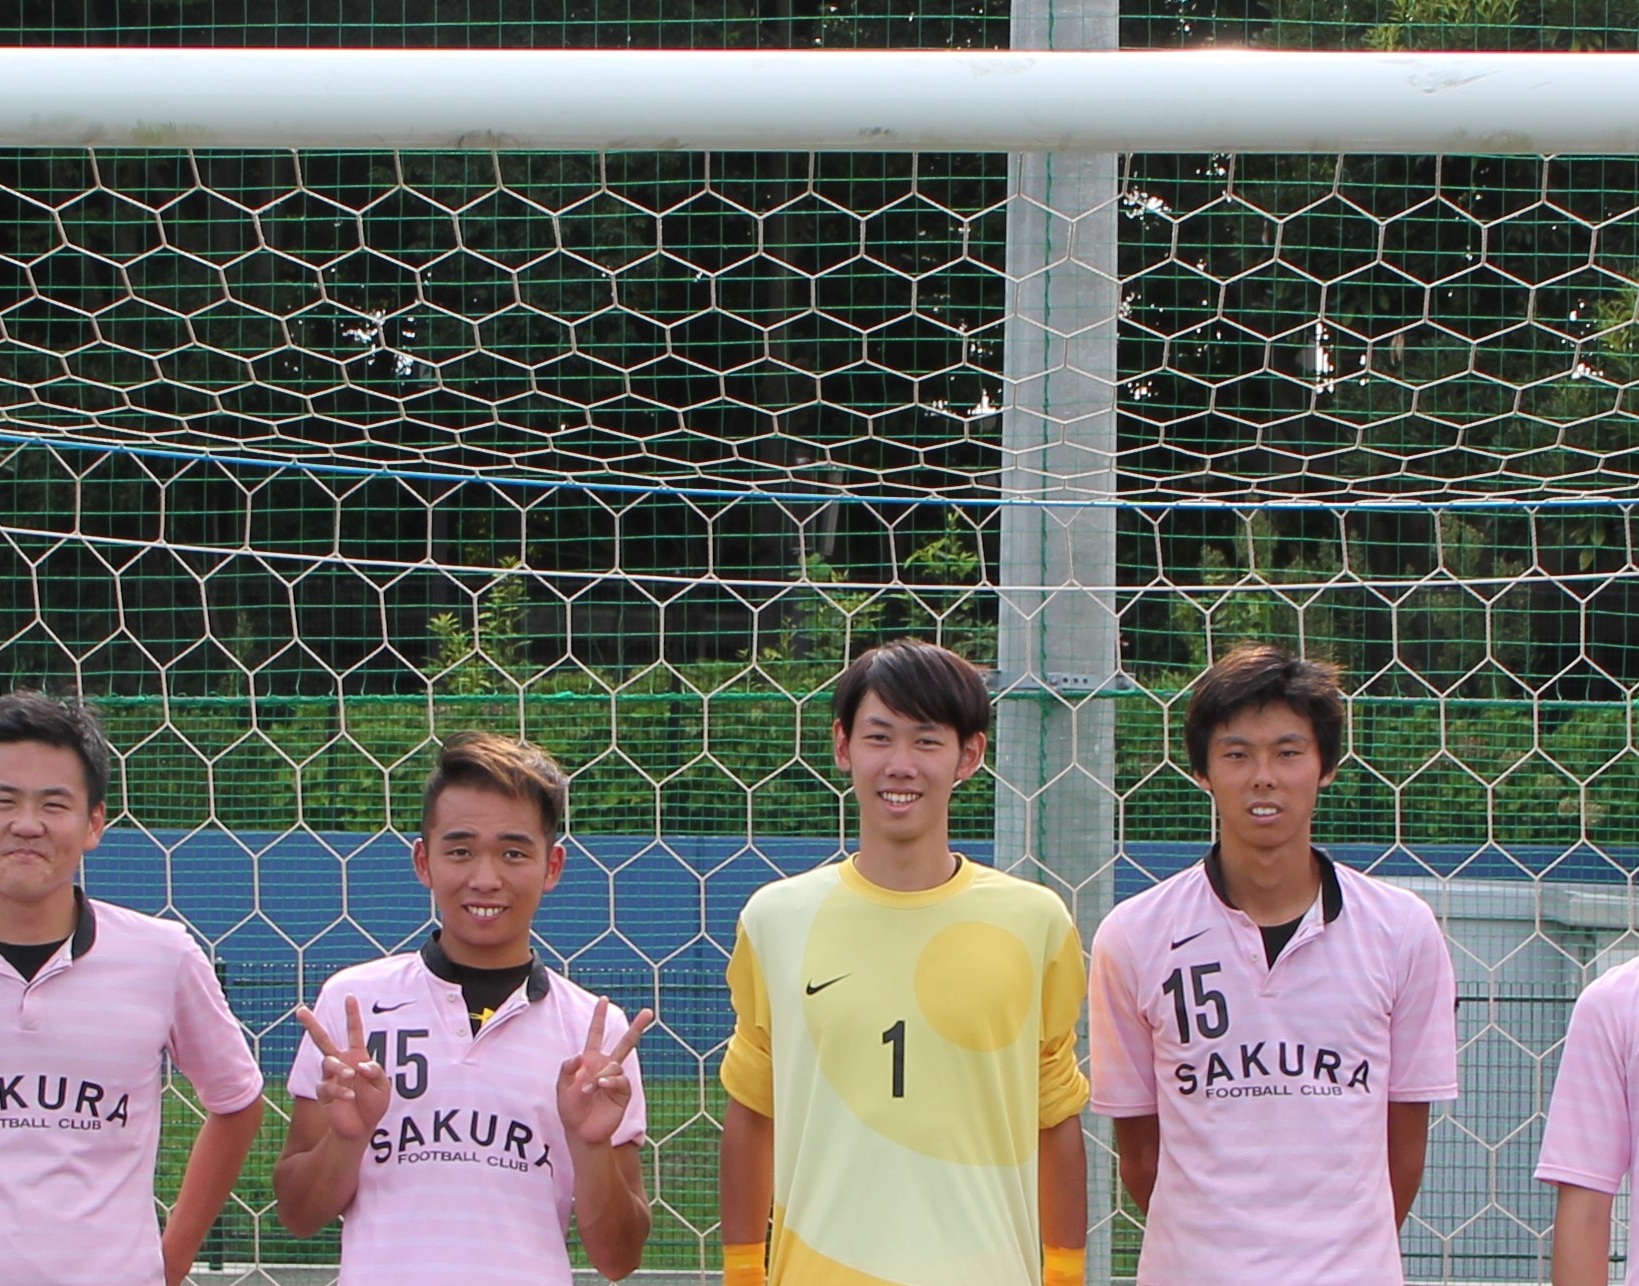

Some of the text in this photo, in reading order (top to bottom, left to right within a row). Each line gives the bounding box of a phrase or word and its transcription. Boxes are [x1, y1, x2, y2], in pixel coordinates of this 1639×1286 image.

[1162, 962, 1229, 1045] 15
[881, 1020, 905, 1098] 1
[1175, 1042, 1371, 1095] SAKURA
[1205, 1083, 1343, 1099] FOOTBALL CLUB
[58, 1119, 102, 1131] CLUB
[398, 1151, 529, 1173] FOOTBALL CLUB
